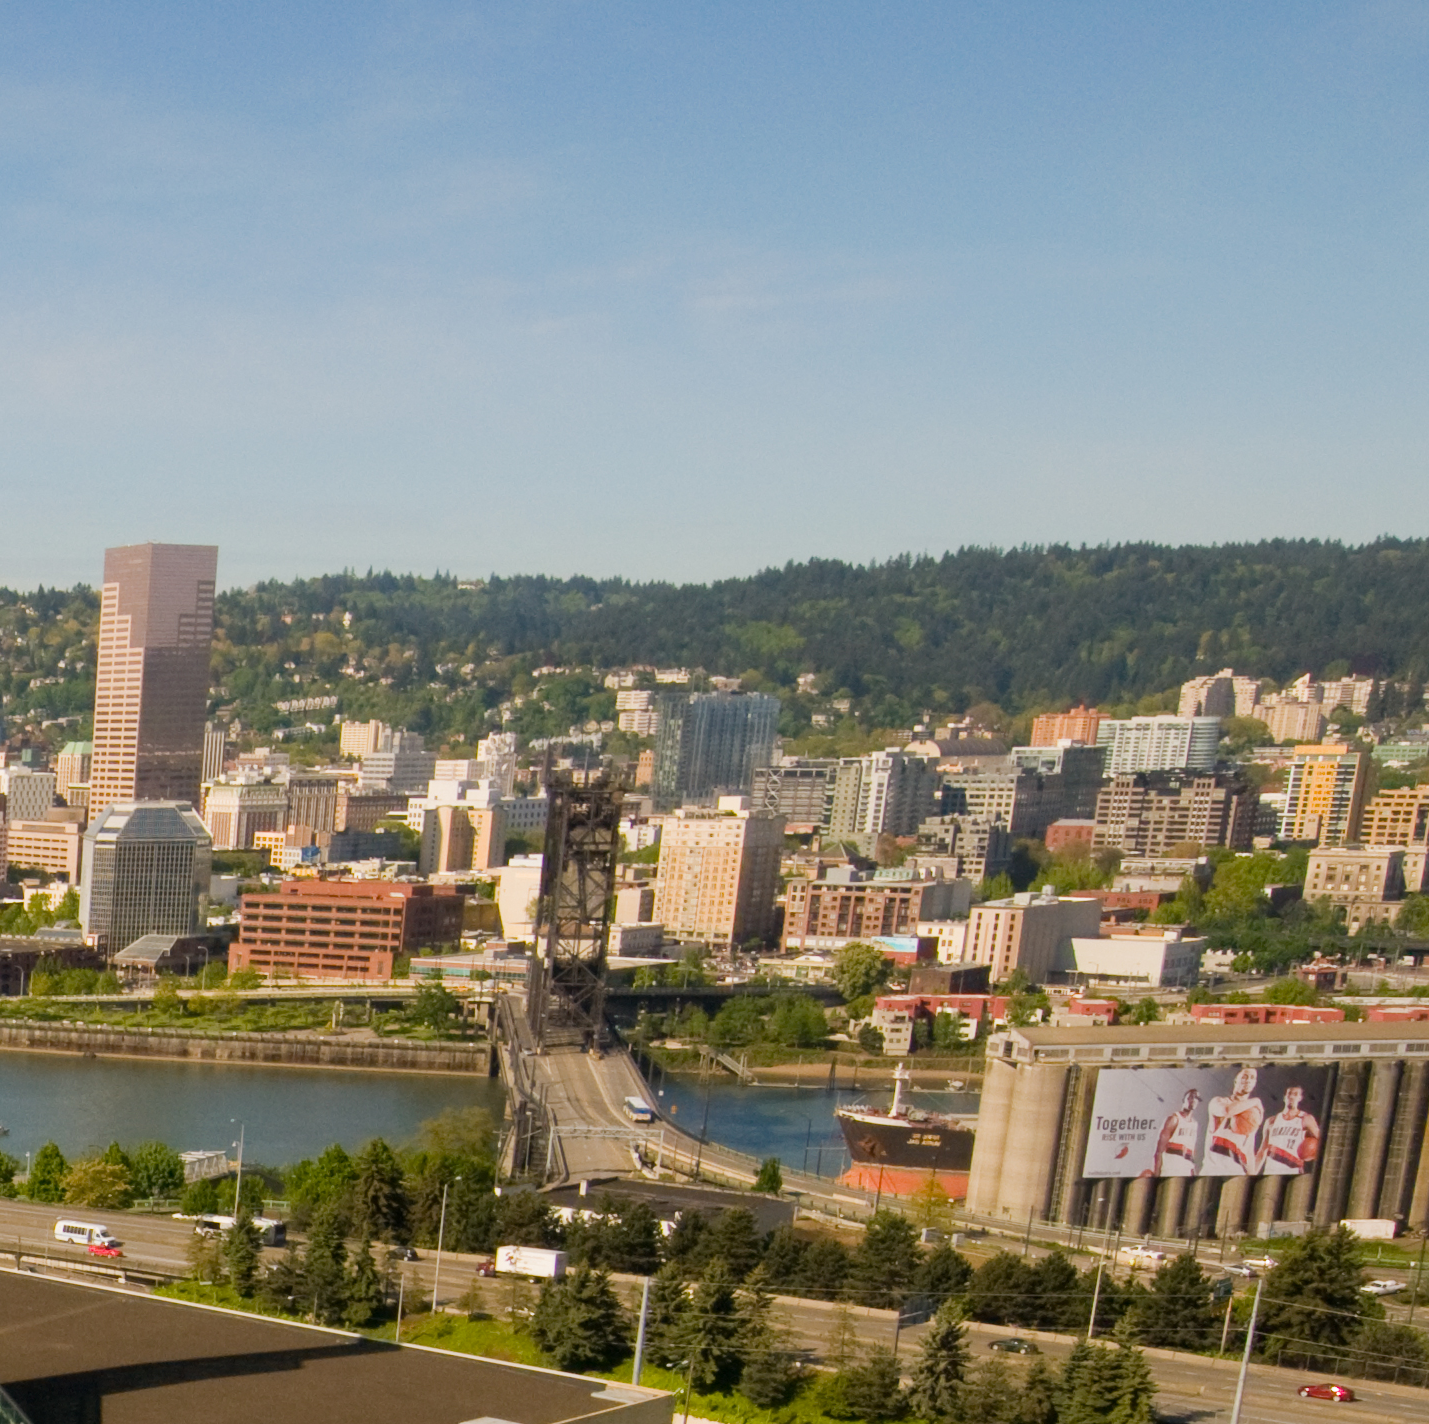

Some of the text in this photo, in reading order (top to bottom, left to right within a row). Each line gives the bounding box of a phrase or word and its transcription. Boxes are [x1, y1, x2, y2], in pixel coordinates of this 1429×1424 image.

[1096, 1116, 1157, 1133] Together.
[1102, 1133, 1146, 1141] RISE WITH US
